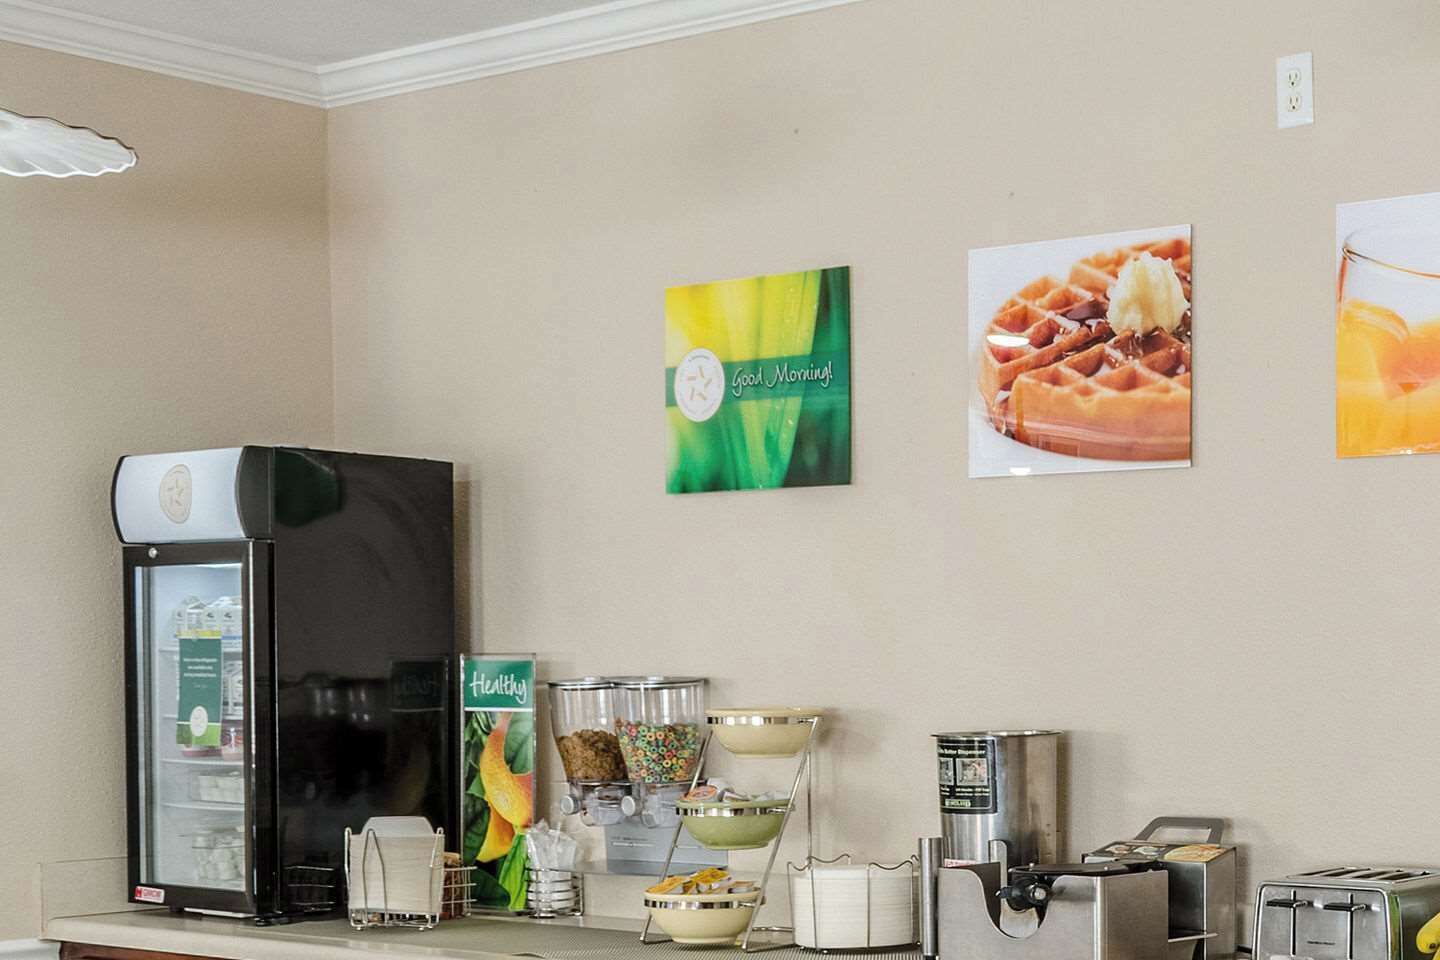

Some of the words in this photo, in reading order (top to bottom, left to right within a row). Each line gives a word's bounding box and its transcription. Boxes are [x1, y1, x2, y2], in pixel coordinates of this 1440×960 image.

[732, 367, 763, 397] Good
[766, 360, 833, 388] Morning!
[469, 671, 527, 704] Healthy
